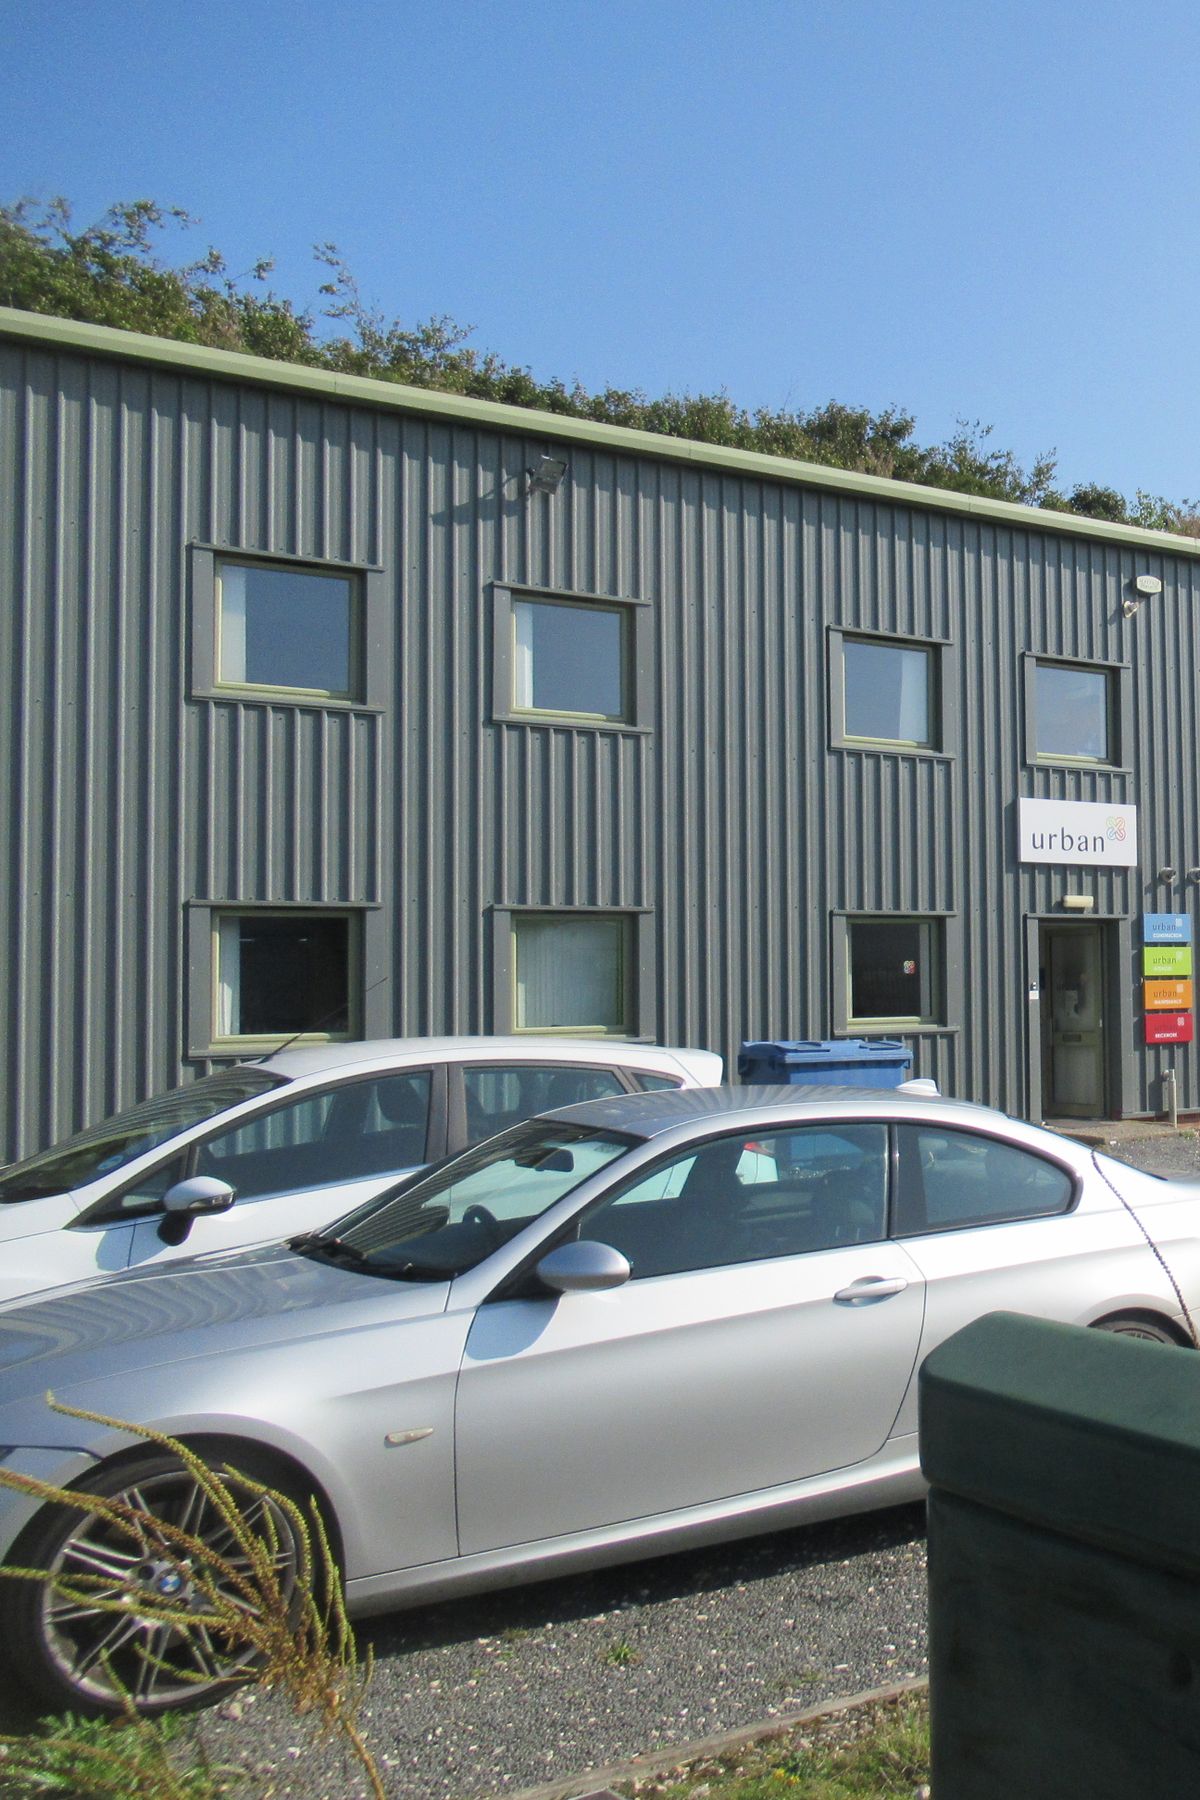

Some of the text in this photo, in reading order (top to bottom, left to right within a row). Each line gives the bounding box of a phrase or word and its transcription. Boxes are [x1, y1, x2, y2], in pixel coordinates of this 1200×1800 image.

[1032, 827, 1105, 853] urban
[1152, 922, 1176, 931] urban
[1152, 956, 1177, 964] urban
[1153, 989, 1177, 997] urban
